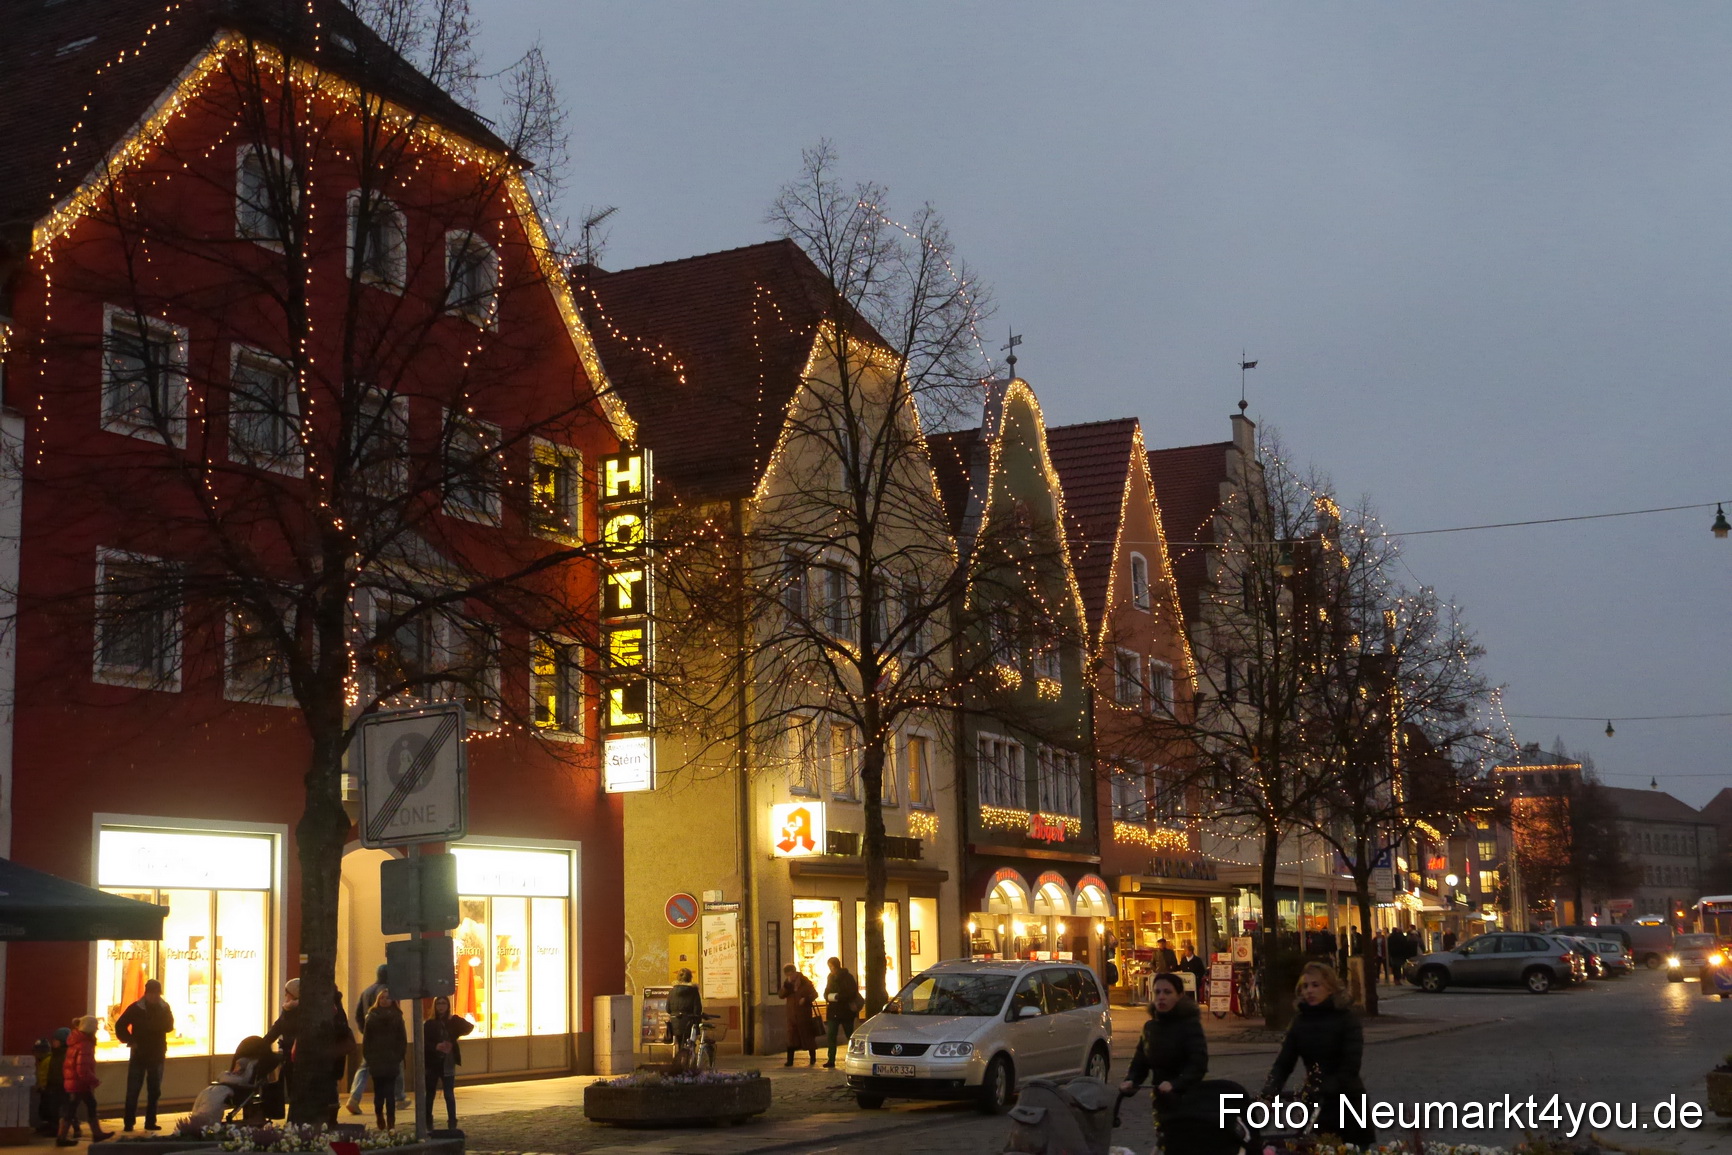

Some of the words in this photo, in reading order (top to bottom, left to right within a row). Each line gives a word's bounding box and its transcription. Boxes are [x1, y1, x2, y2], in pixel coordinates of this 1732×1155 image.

[604, 455, 646, 728] HOTEL
[612, 754, 641, 766] Stern
[389, 805, 437, 827] ZONE
[703, 940, 736, 957] VENEZIA
[901, 1065, 914, 1075] 334
